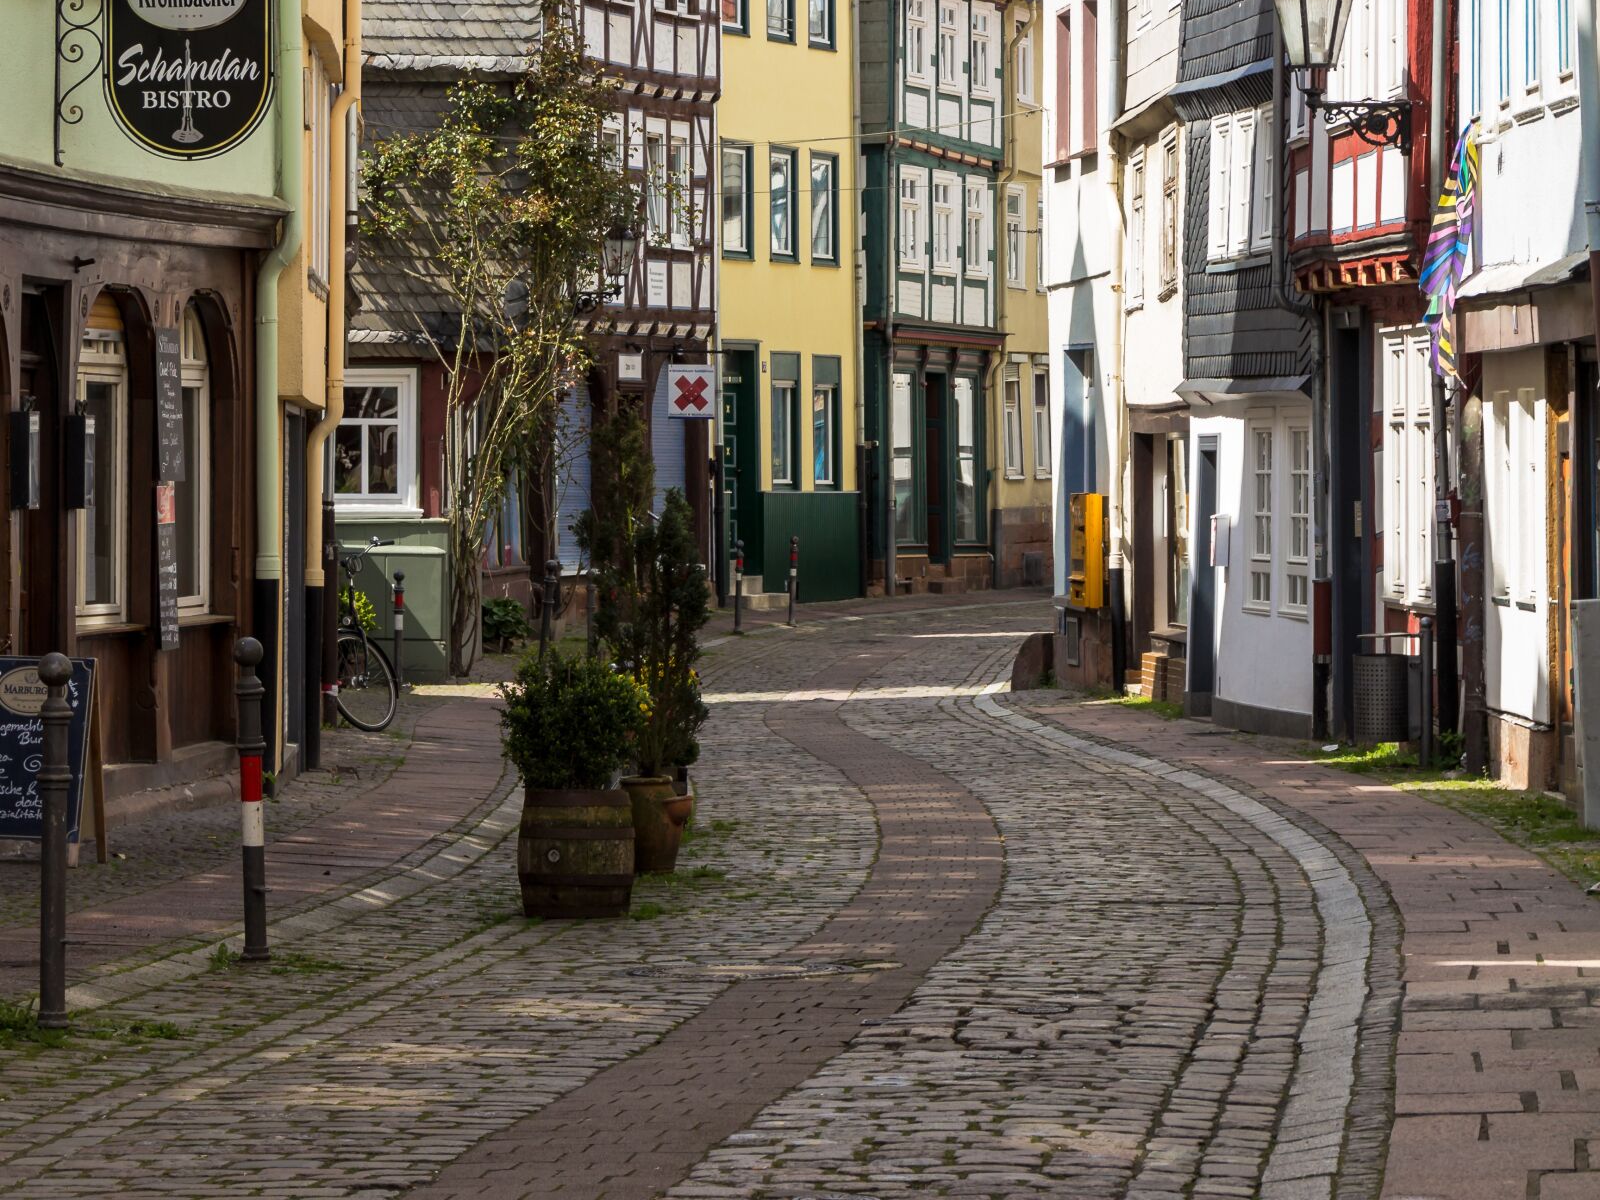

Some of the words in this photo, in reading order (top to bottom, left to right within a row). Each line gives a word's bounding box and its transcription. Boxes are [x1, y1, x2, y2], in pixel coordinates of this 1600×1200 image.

[117, 43, 260, 86] Schamdan
[142, 90, 231, 109] BISTRO
[4, 684, 49, 695] MARBURG
[18, 731, 43, 745] Bur
